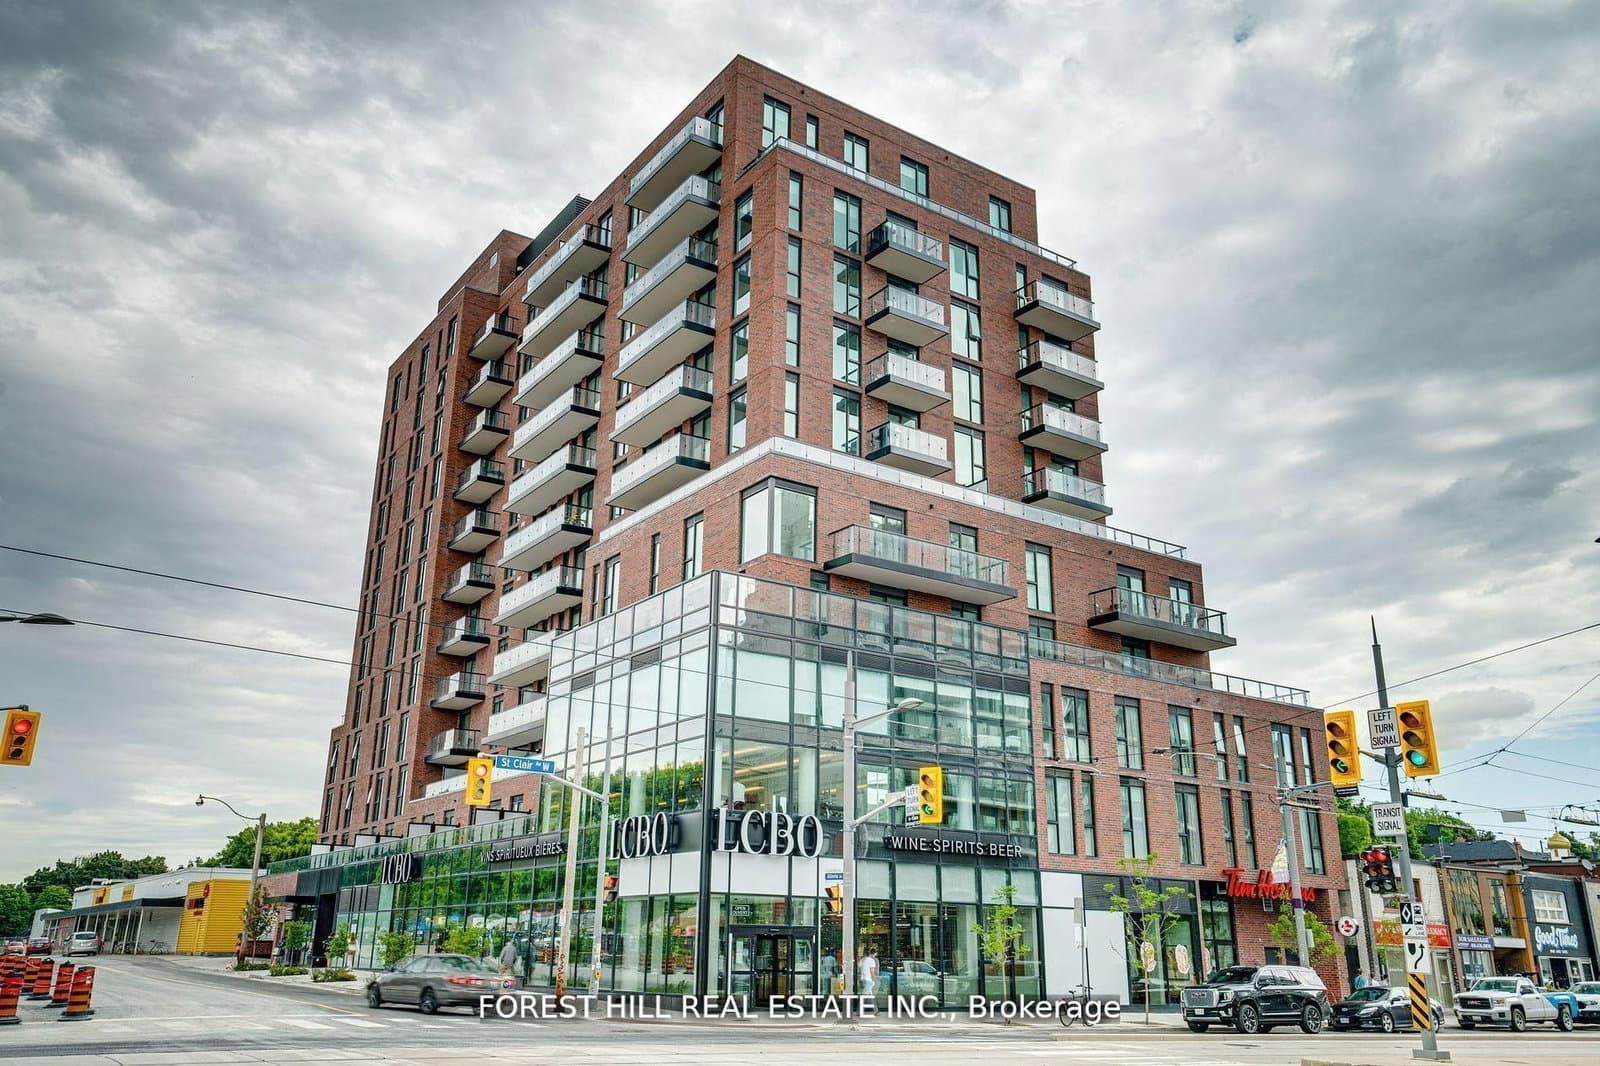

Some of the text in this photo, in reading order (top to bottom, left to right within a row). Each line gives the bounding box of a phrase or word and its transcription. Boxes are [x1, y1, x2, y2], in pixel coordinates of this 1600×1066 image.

[1373, 711, 1392, 722] LEFT
[1374, 723, 1394, 734] TURN
[1372, 735, 1399, 746] SIGNAL
[501, 757, 511, 767] St
[513, 759, 533, 769] Clair
[542, 762, 550, 771] W
[1374, 807, 1401, 819] TRANSIT
[716, 808, 823, 858] LCBO
[1377, 820, 1402, 831] SIGNAL
[609, 811, 668, 860] LCBO
[495, 846, 534, 861] SPIRITUEUX
[891, 836, 1022, 858] WINE SPIRITS BEER
[381, 852, 412, 884] LCBO
[1223, 869, 1256, 898] Tim
[1535, 926, 1578, 951] Good Times
